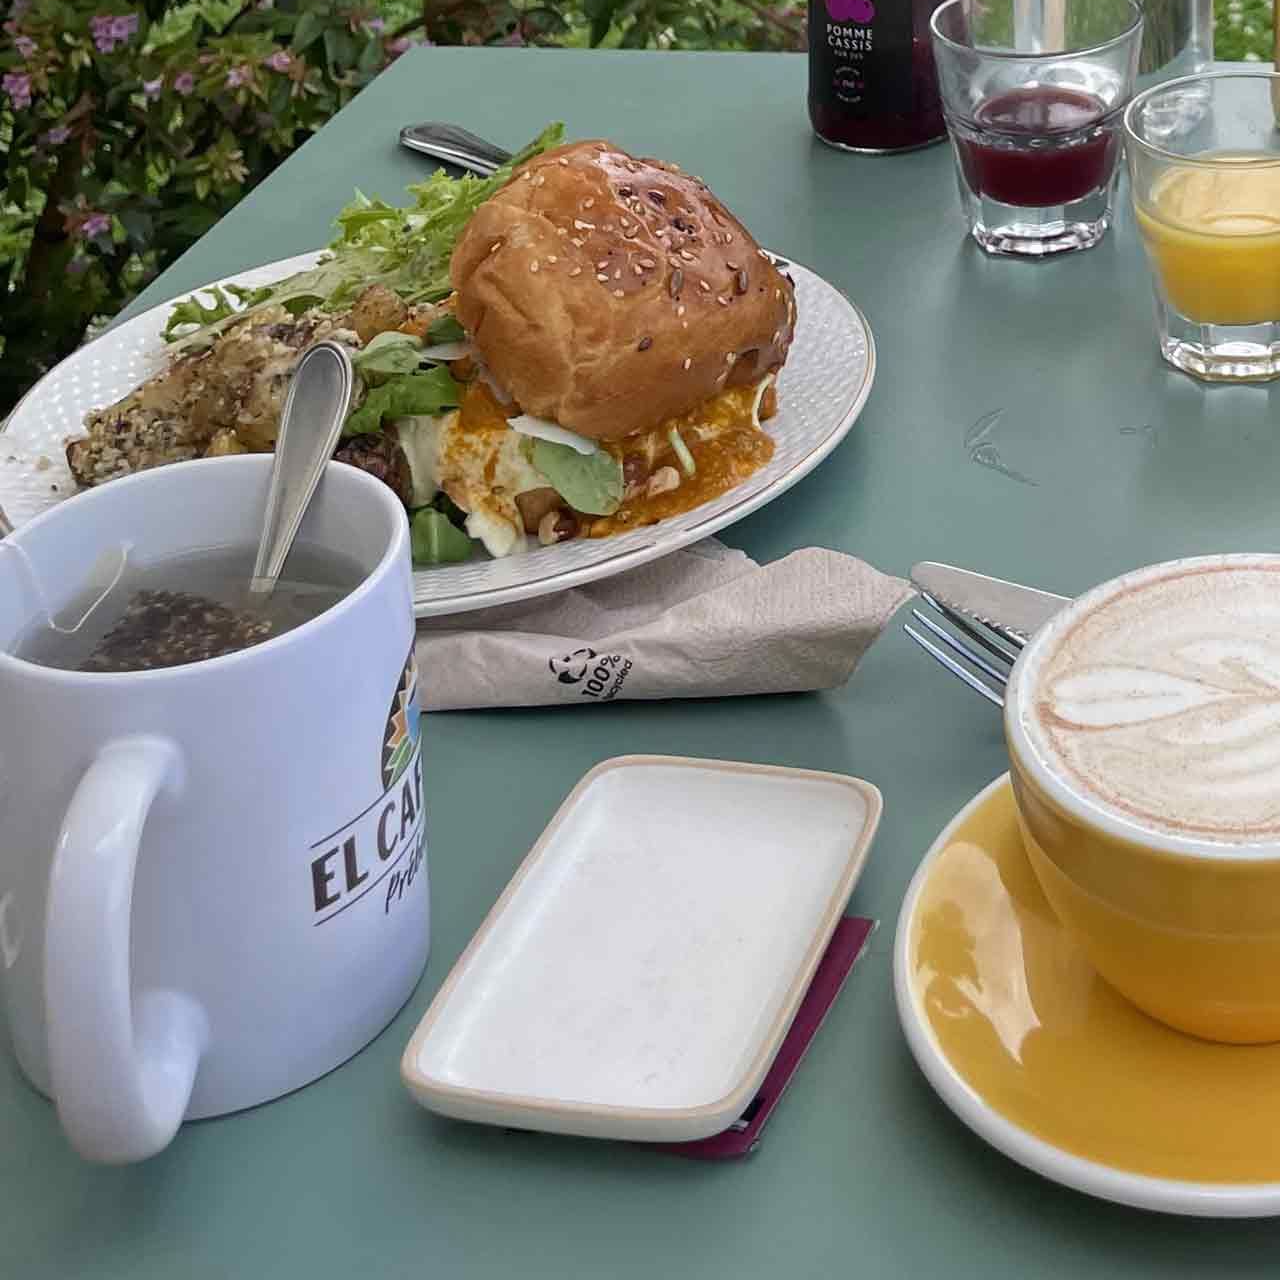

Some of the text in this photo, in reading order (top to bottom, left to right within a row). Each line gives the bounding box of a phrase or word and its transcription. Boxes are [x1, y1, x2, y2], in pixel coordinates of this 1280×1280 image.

[826, 23, 873, 41] POMME
[827, 35, 873, 52] CASSIS
[581, 655, 621, 697] 100%
[311, 834, 369, 913] EL
